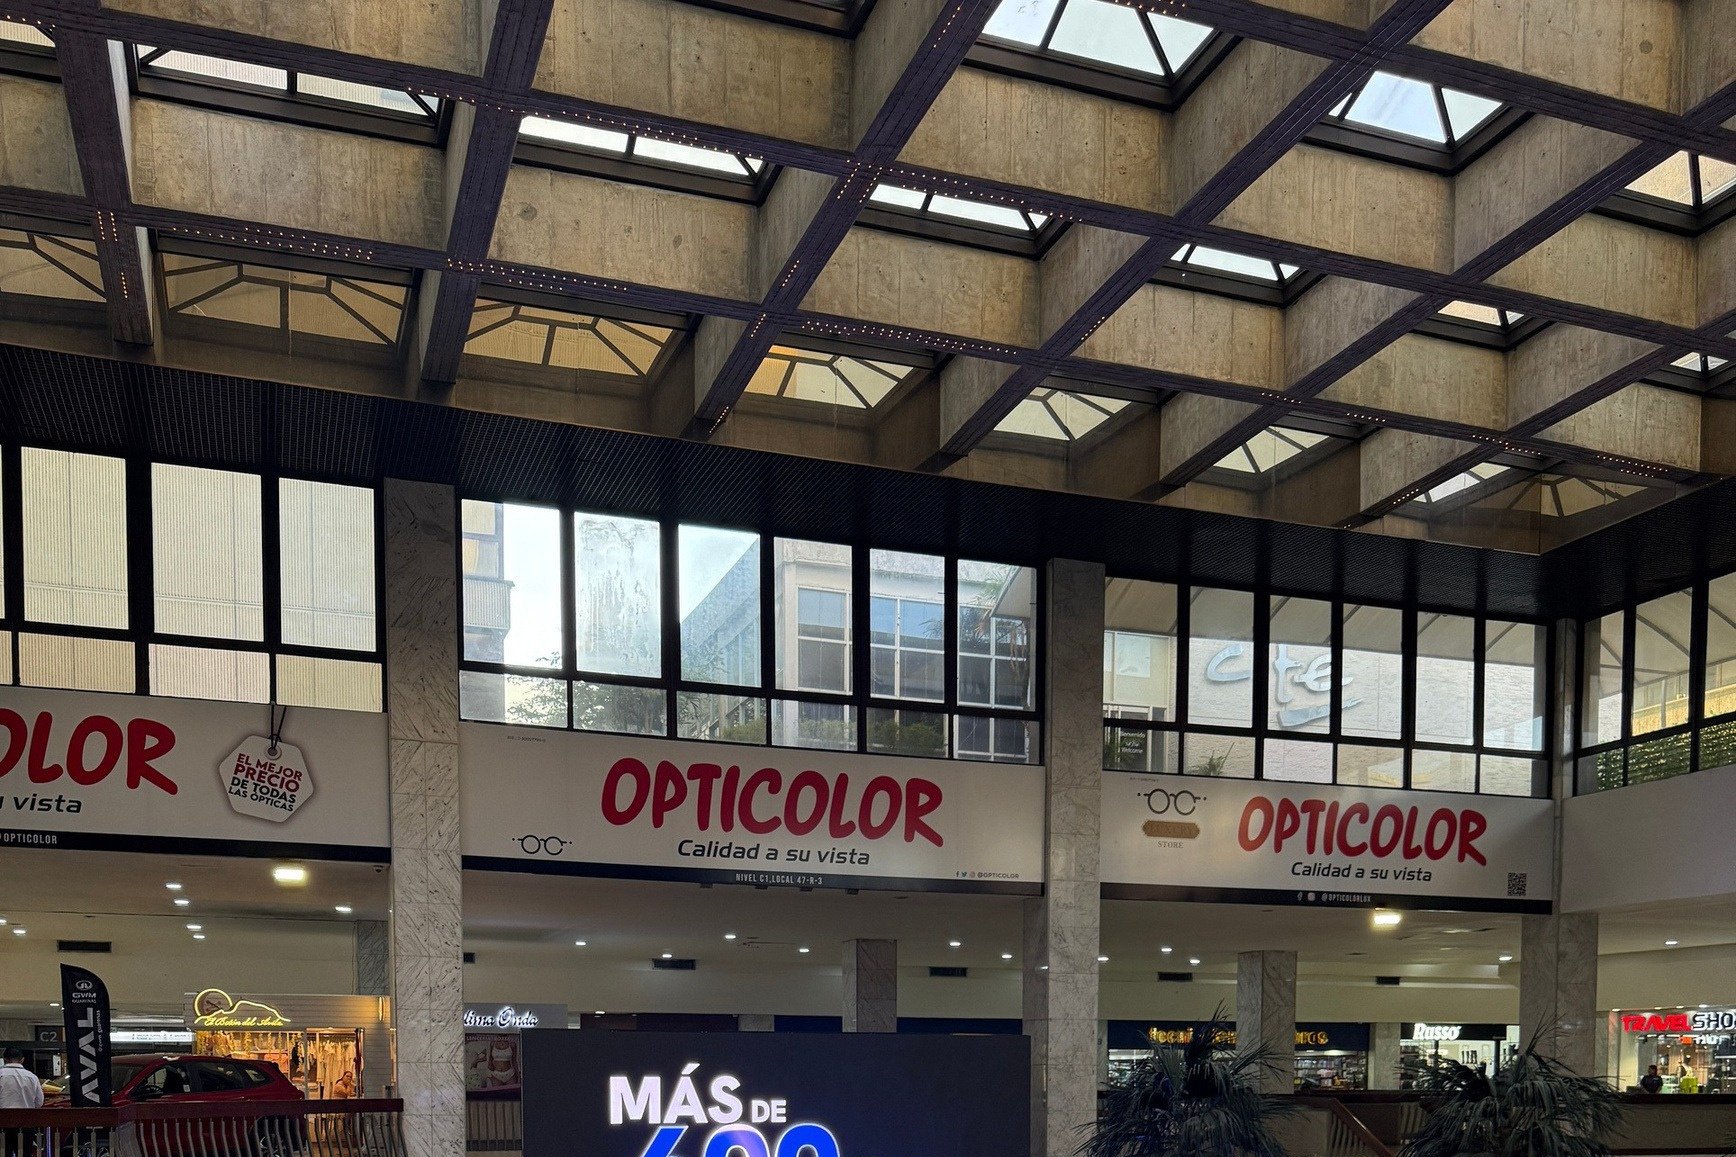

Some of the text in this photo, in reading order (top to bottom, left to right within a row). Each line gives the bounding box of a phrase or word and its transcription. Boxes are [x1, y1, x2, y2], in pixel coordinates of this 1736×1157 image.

[233, 763, 300, 793] PRECIO
[237, 753, 302, 781] EL MEJOR
[228, 786, 248, 798] LAS
[231, 777, 297, 803] DE TODAS
[14, 793, 82, 814] vista
[601, 757, 944, 848] OPTICOLOR
[0, 833, 58, 845] OPTICOLOR
[1238, 796, 1487, 867] OPTICOLOR
[678, 839, 870, 865] Calidad a su vista
[1157, 841, 1184, 849] STORE
[735, 873, 757, 882] NIVEL
[977, 871, 1020, 879] @OPTICOLOR
[1291, 862, 1432, 881] Calidad a su vista
[498, 1006, 539, 1028] Onda
[1621, 1011, 1736, 1034] TRAVEL SHO
[39, 1031, 58, 1042] C2
[1413, 1022, 1462, 1040] Russo
[77, 1007, 101, 1104] AVAL
[609, 1062, 787, 1125] MÁS DE
